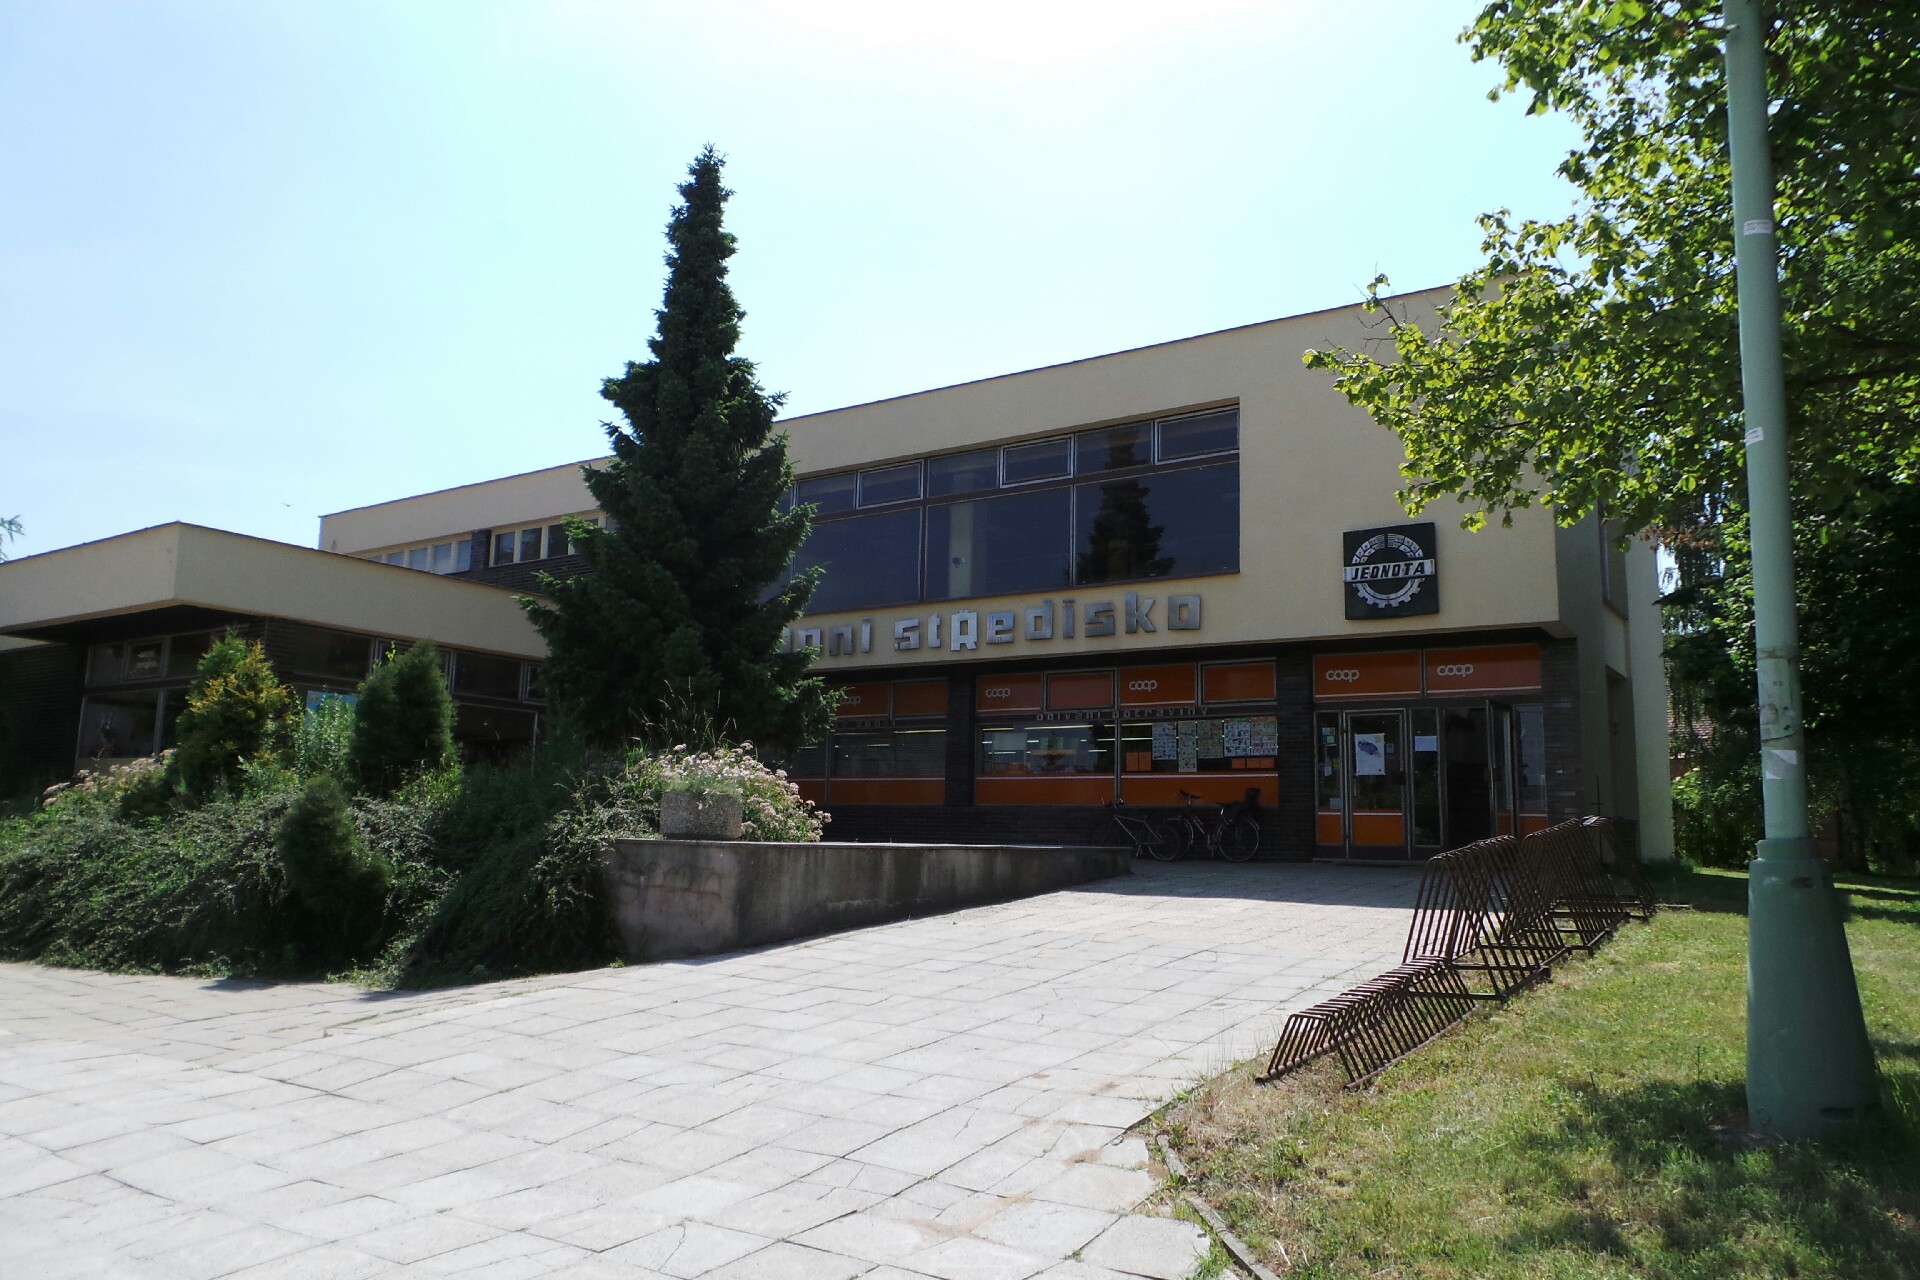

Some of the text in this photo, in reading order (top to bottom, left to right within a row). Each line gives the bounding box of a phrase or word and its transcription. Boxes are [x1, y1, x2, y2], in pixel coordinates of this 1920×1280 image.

[1351, 562, 1425, 580] JEDNOTA
[1325, 669, 1360, 682] coop
[1436, 663, 1473, 678] coop
[1129, 679, 1158, 692] coop
[985, 687, 1011, 699] coop
